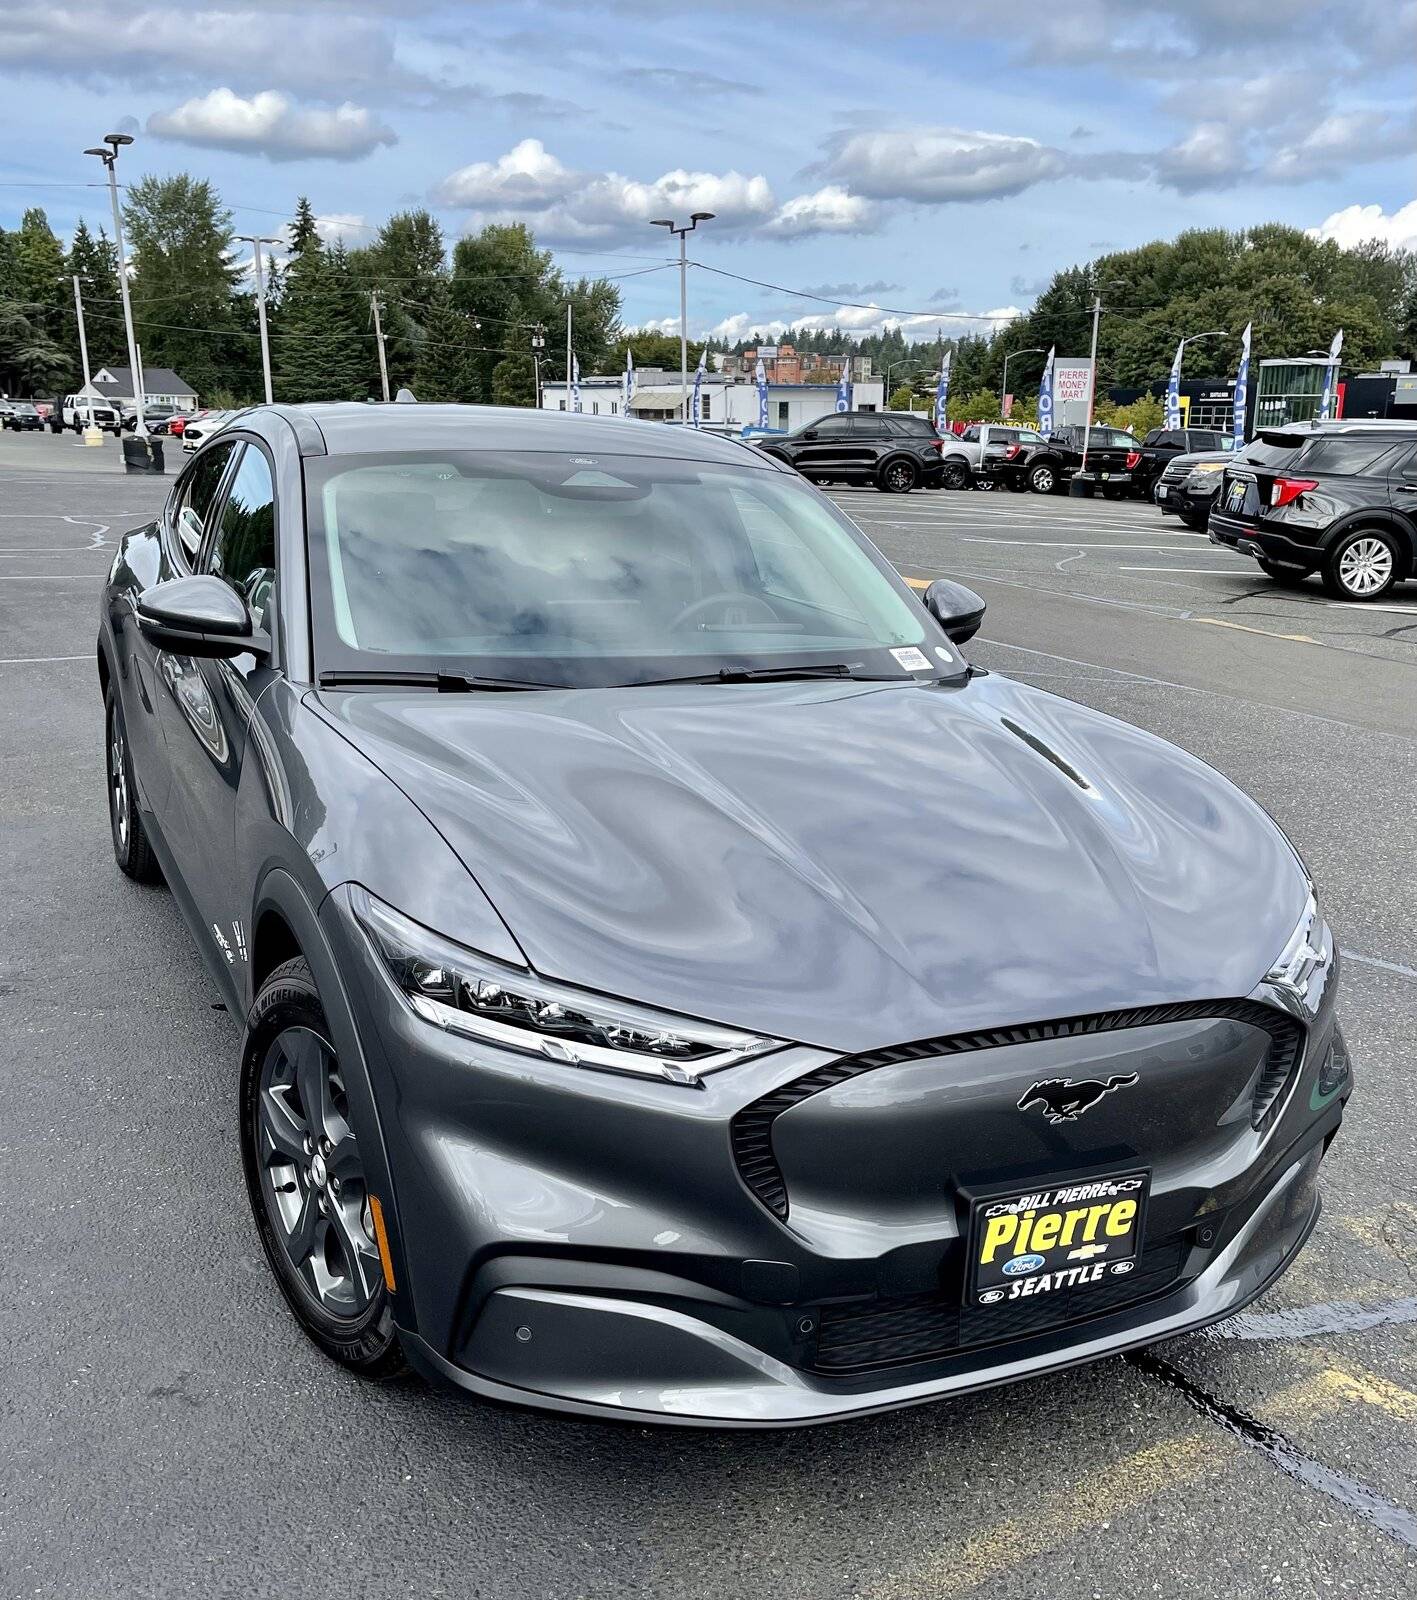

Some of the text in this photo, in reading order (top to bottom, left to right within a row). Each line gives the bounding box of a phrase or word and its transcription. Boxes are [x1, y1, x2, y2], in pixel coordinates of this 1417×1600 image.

[1059, 370, 1089, 380] PIERRE
[1058, 380, 1087, 389] MONEY
[1061, 390, 1084, 398] MART
[1016, 1181, 1112, 1212] BILL PIERRE
[980, 1199, 1137, 1264] Pierre
[1006, 1256, 1041, 1274] Ford
[1009, 1262, 1107, 1300] SEATTLE
